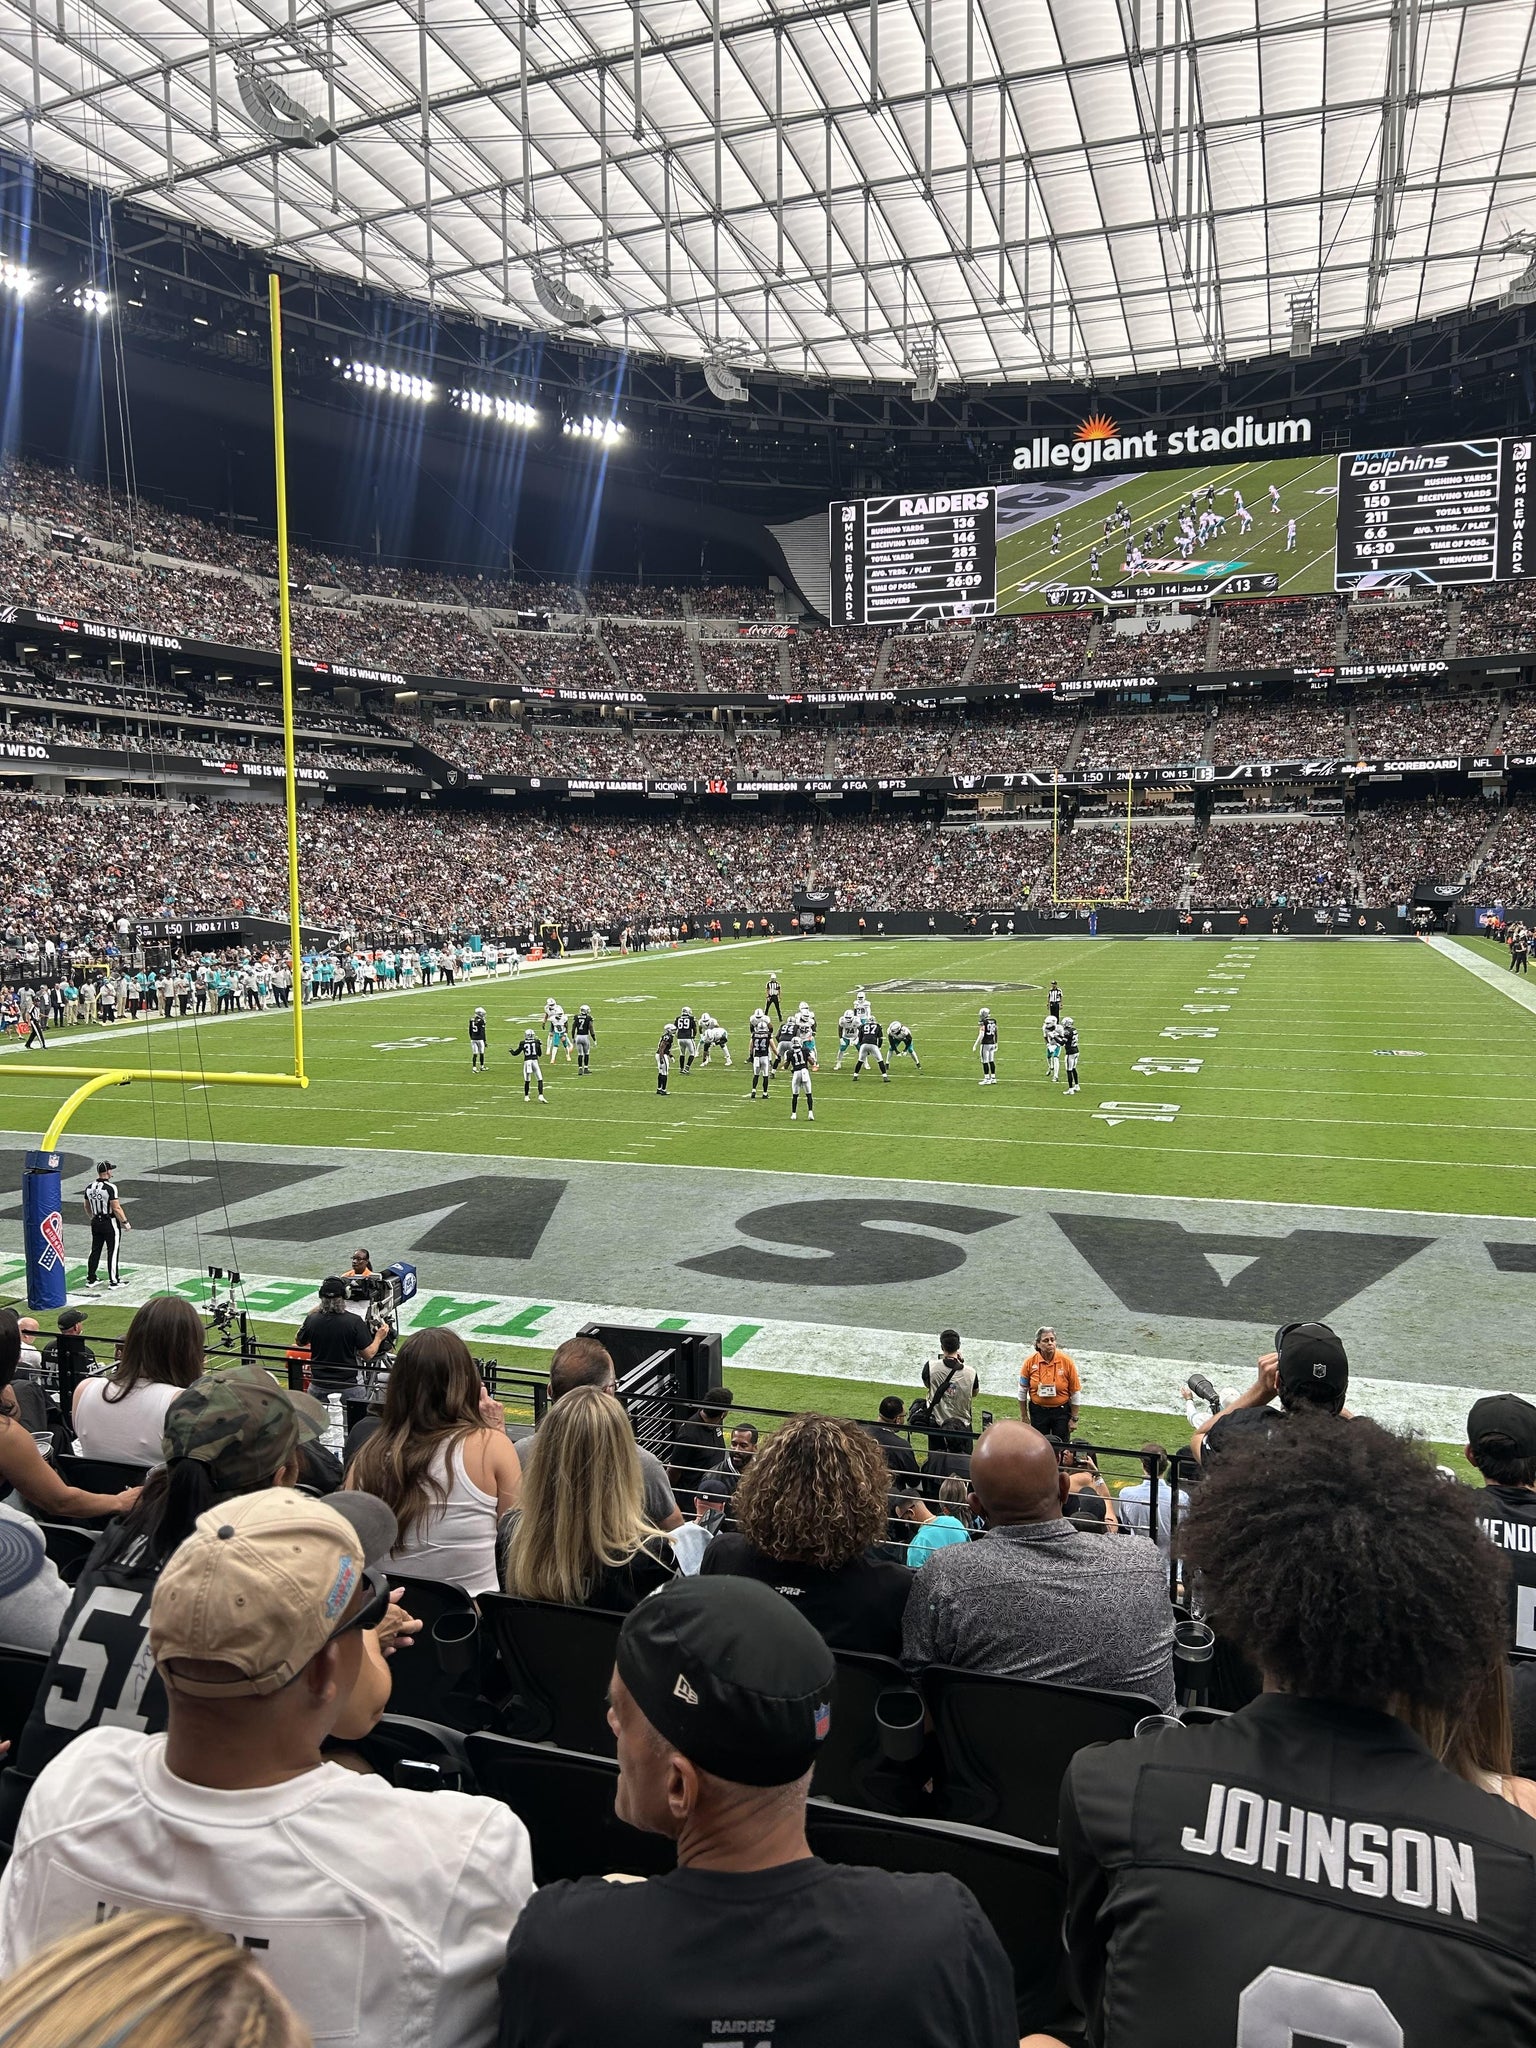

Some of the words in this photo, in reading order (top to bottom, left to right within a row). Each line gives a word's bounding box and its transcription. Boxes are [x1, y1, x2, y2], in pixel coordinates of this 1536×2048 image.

[1012, 429, 1157, 472] allegiant
[1167, 415, 1311, 455] stadium
[1355, 451, 1397, 462] MIAMI
[1350, 454, 1450, 477] Dolphins
[1368, 479, 1387, 492] 61
[1424, 476, 1463, 487] RUSHING
[1464, 473, 1492, 483] YARDS
[1514, 461, 1527, 494] MGM
[899, 492, 989, 517] RAIDERS
[1363, 495, 1391, 508] 150
[1417, 492, 1463, 502] RECEIVING
[1464, 489, 1492, 499] YARDS
[1364, 511, 1389, 524] 211
[1436, 507, 1461, 516] TOTAL
[1462, 505, 1491, 514] YARDS
[902, 524, 925, 533] YARDS
[952, 517, 976, 529] 136
[1364, 527, 1388, 540] 6.6
[1413, 526, 1433, 535] AVG.
[1434, 524, 1460, 533] YRDS.
[1468, 521, 1490, 530] PLAY
[844, 523, 853, 551] MGM
[871, 538, 907, 549] RECEIVING
[907, 538, 930, 546] YARDS
[952, 532, 976, 544] 146
[1512, 498, 1525, 574] REWARDS.
[1355, 542, 1395, 556] 16:30
[1430, 541, 1451, 550] TIME
[1451, 540, 1463, 548] OF
[1464, 538, 1490, 547] POSS.
[871, 555, 891, 563] TOTAL
[892, 553, 914, 562] YARDS
[951, 546, 977, 558] 282
[915, 566, 932, 575] PLAY
[954, 561, 974, 573] 5.6
[1371, 559, 1379, 570] 1
[1439, 554, 1489, 565] TURNOVERS
[844, 555, 855, 620] REWARDS.
[871, 585, 887, 593] TIME
[946, 575, 982, 588] 26:09
[1165, 585, 1177, 595] 14
[1182, 585, 1196, 593] 2nd
[1236, 580, 1251, 592] 13
[871, 596, 910, 606] TURNOVERS
[960, 590, 967, 600] 1
[1072, 591, 1086, 603] 27
[1136, 587, 1155, 596] 1:50
[82, 623, 106, 638] THIS
[107, 628, 117, 639] IS
[119, 630, 147, 644] WHAT
[148, 636, 163, 648] WE
[164, 638, 182, 650] DO.
[332, 665, 349, 677] THIS
[350, 667, 357, 678] IS
[357, 669, 379, 681] WHAT
[380, 672, 391, 683] WE
[392, 673, 406, 685] DO.
[1340, 666, 1364, 676] THIS
[1365, 665, 1375, 675] IS
[1376, 664, 1408, 674] WHAT
[1409, 663, 1427, 672] WE
[1428, 662, 1449, 671] DO.
[1061, 681, 1082, 691] THIS
[1083, 680, 1092, 689] IS
[1093, 679, 1122, 689] WHAT
[1123, 678, 1138, 687] WE
[1140, 677, 1158, 686] DO.
[559, 690, 578, 700] THIS
[579, 691, 587, 700] IS
[588, 691, 614, 701] WHAT
[615, 692, 629, 702] WE
[630, 692, 647, 702] DO.
[807, 694, 827, 703] THIS
[828, 693, 836, 702] IS
[837, 693, 864, 702] WHAT
[865, 692, 880, 701] WE
[881, 691, 897, 700] DO.
[6, 744, 26, 758] WE
[28, 746, 50, 759] DO.
[1383, 759, 1458, 771] SCOREBOARD
[1473, 759, 1492, 768] NFL
[243, 765, 262, 776] THIS
[263, 766, 272, 776] IS
[272, 767, 299, 779] WHT
[299, 769, 312, 779] WE
[313, 770, 329, 780] DO.
[1082, 773, 1104, 782] 1:50
[1116, 771, 1134, 780] 2ND
[1134, 771, 1141, 780] &
[1142, 771, 1149, 780] 7
[1162, 771, 1175, 779] ON
[1177, 770, 1189, 779] 15
[568, 780, 605, 790] FANTASY
[606, 780, 643, 791] LEADERS
[655, 782, 687, 791] KICKING
[805, 783, 811, 791] 4
[812, 781, 831, 791] FGM
[842, 781, 848, 790] 4
[849, 781, 868, 790] FGA
[878, 781, 888, 790] 15
[889, 780, 906, 789] PTS
[135, 925, 142, 936] 3
[164, 924, 182, 935] 1:50
[195, 924, 209, 932] 2ND
[210, 923, 216, 931] &
[217, 922, 222, 930] 7
[230, 921, 239, 930] 13
[471, 1022, 478, 1033] 5
[578, 1019, 585, 1030] 7
[678, 1018, 690, 1030] 69
[781, 1024, 794, 1034] 94
[863, 1024, 878, 1035] 97
[523, 1043, 537, 1055] 31
[754, 1039, 767, 1051] 44
[45, 1586, 155, 1732] 51
[1181, 1782, 1478, 1923] JOHNSON
[711, 2019, 776, 2034] RAIDERS
